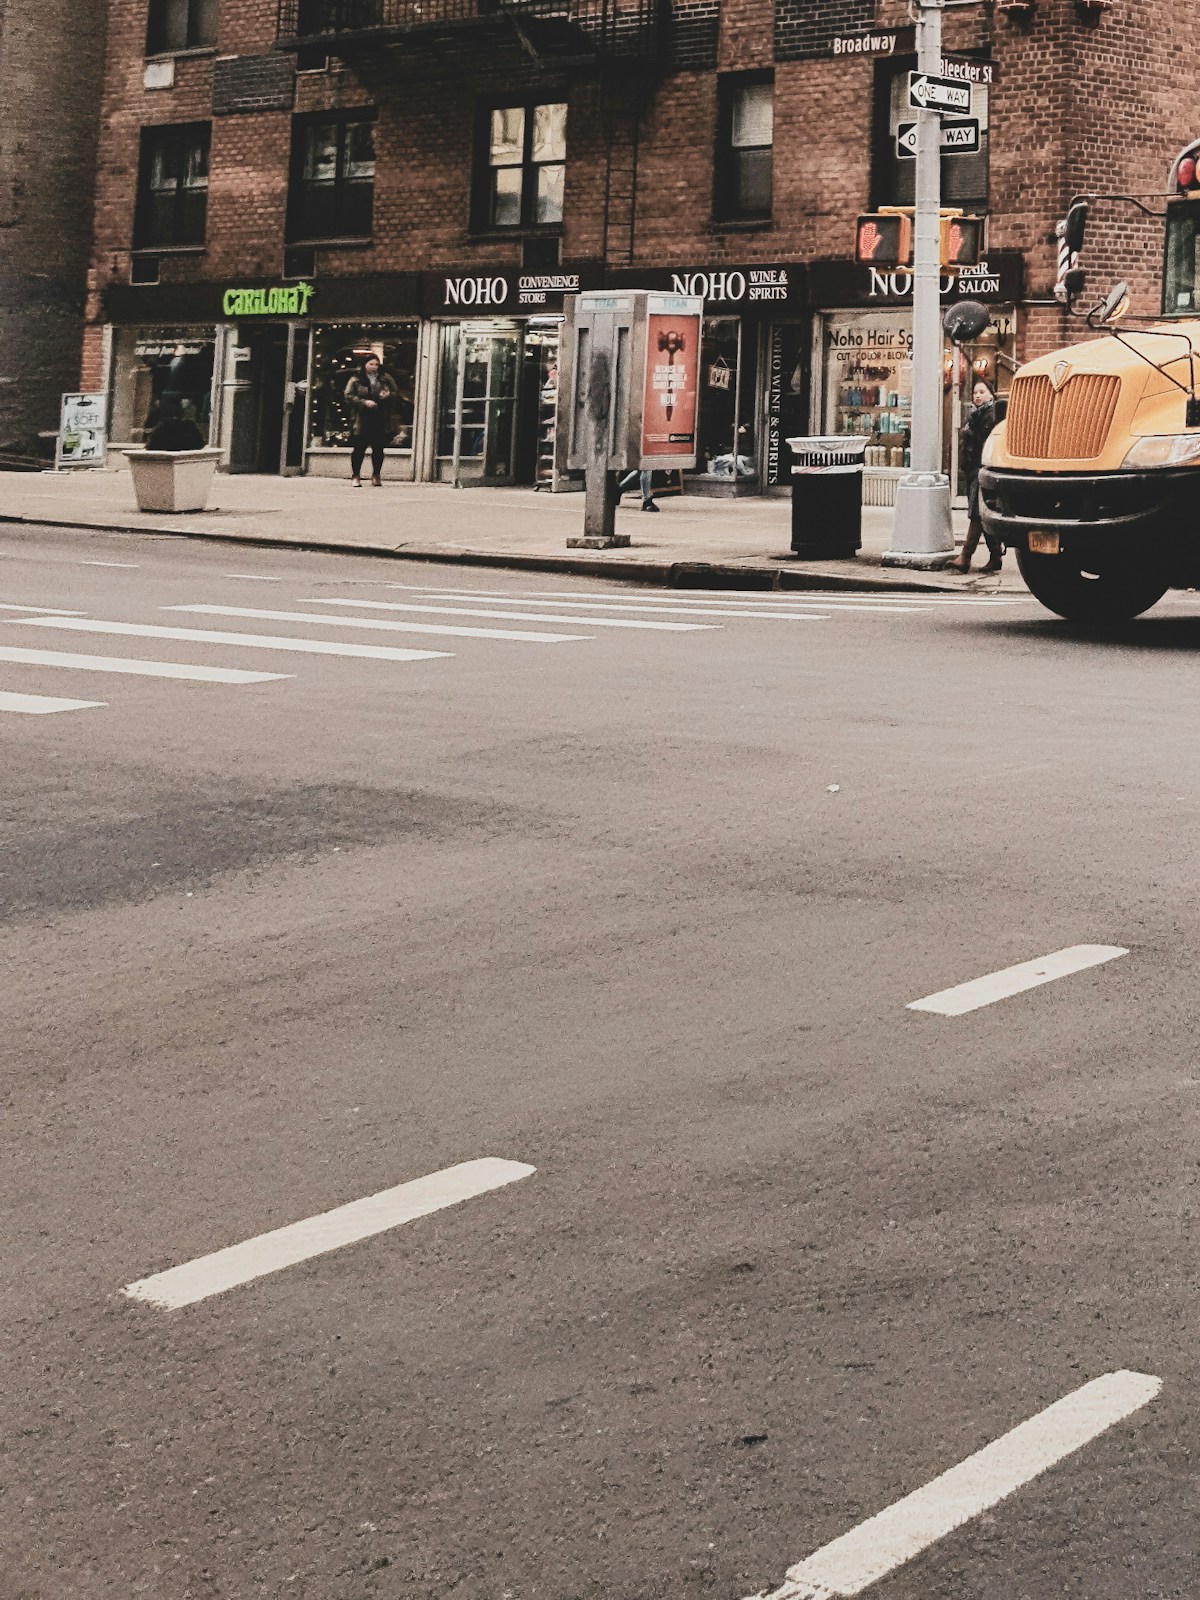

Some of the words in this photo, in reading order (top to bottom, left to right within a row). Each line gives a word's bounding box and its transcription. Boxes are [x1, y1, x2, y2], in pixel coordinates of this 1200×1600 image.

[833, 34, 897, 54] Broadway
[939, 58, 981, 82] Bleecker
[982, 65, 993, 83] St
[917, 84, 937, 100] ONE
[946, 89, 967, 104] WAY
[945, 129, 972, 144] WAY
[518, 274, 580, 289] CONVENIENCE
[749, 270, 777, 283] WINE
[778, 269, 788, 282] &
[868, 264, 955, 297] NOO
[443, 276, 508, 305] NOHO
[670, 271, 746, 301] NOHO
[748, 286, 788, 300] SPIRITS
[958, 279, 1000, 294] SALON
[518, 292, 547, 304] STORE
[829, 328, 863, 347] Noho
[867, 329, 895, 346] Hair
[772, 326, 783, 371] NOHO
[836, 352, 850, 361] CUT
[855, 351, 882, 361] COLOR
[771, 374, 782, 413] WINE
[73, 413, 100, 427] SOFT
[770, 417, 780, 427] &
[768, 430, 780, 485] SPIRITS
